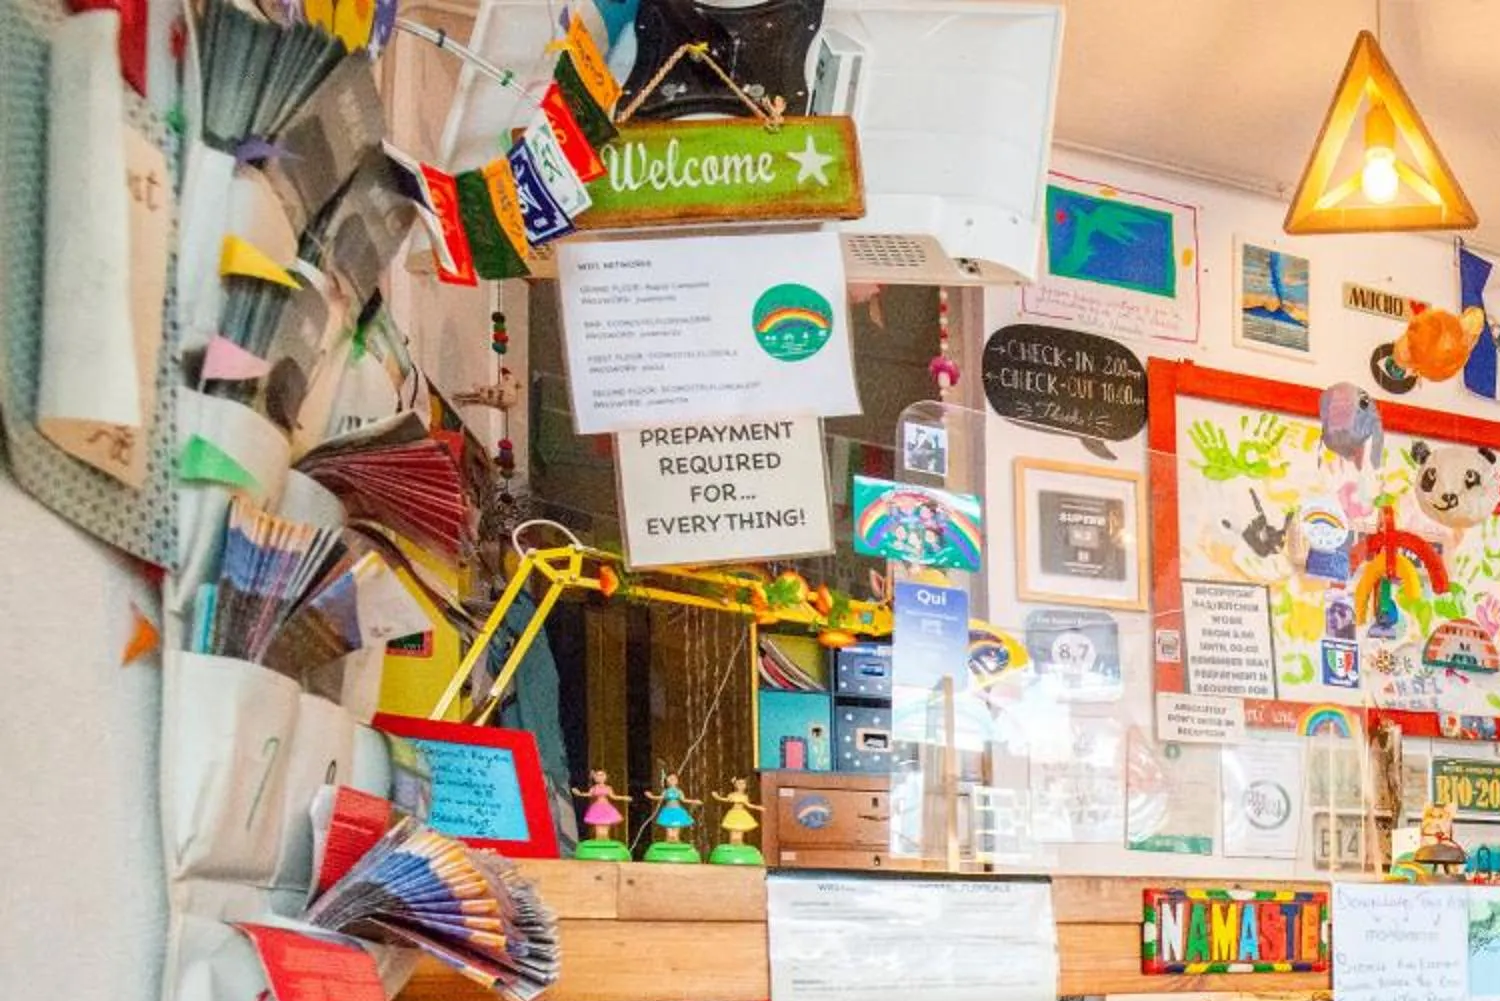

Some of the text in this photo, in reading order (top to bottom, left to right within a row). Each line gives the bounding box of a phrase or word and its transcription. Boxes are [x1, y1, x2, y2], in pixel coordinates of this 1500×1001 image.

[600, 137, 776, 192] Welcome
[640, 421, 794, 448] PREPAYMENT
[659, 452, 781, 476] REQUIRED
[646, 508, 806, 535] EVERYTHING!
[916, 588, 947, 606] Qui
[1160, 903, 1320, 961] NAMASTE
